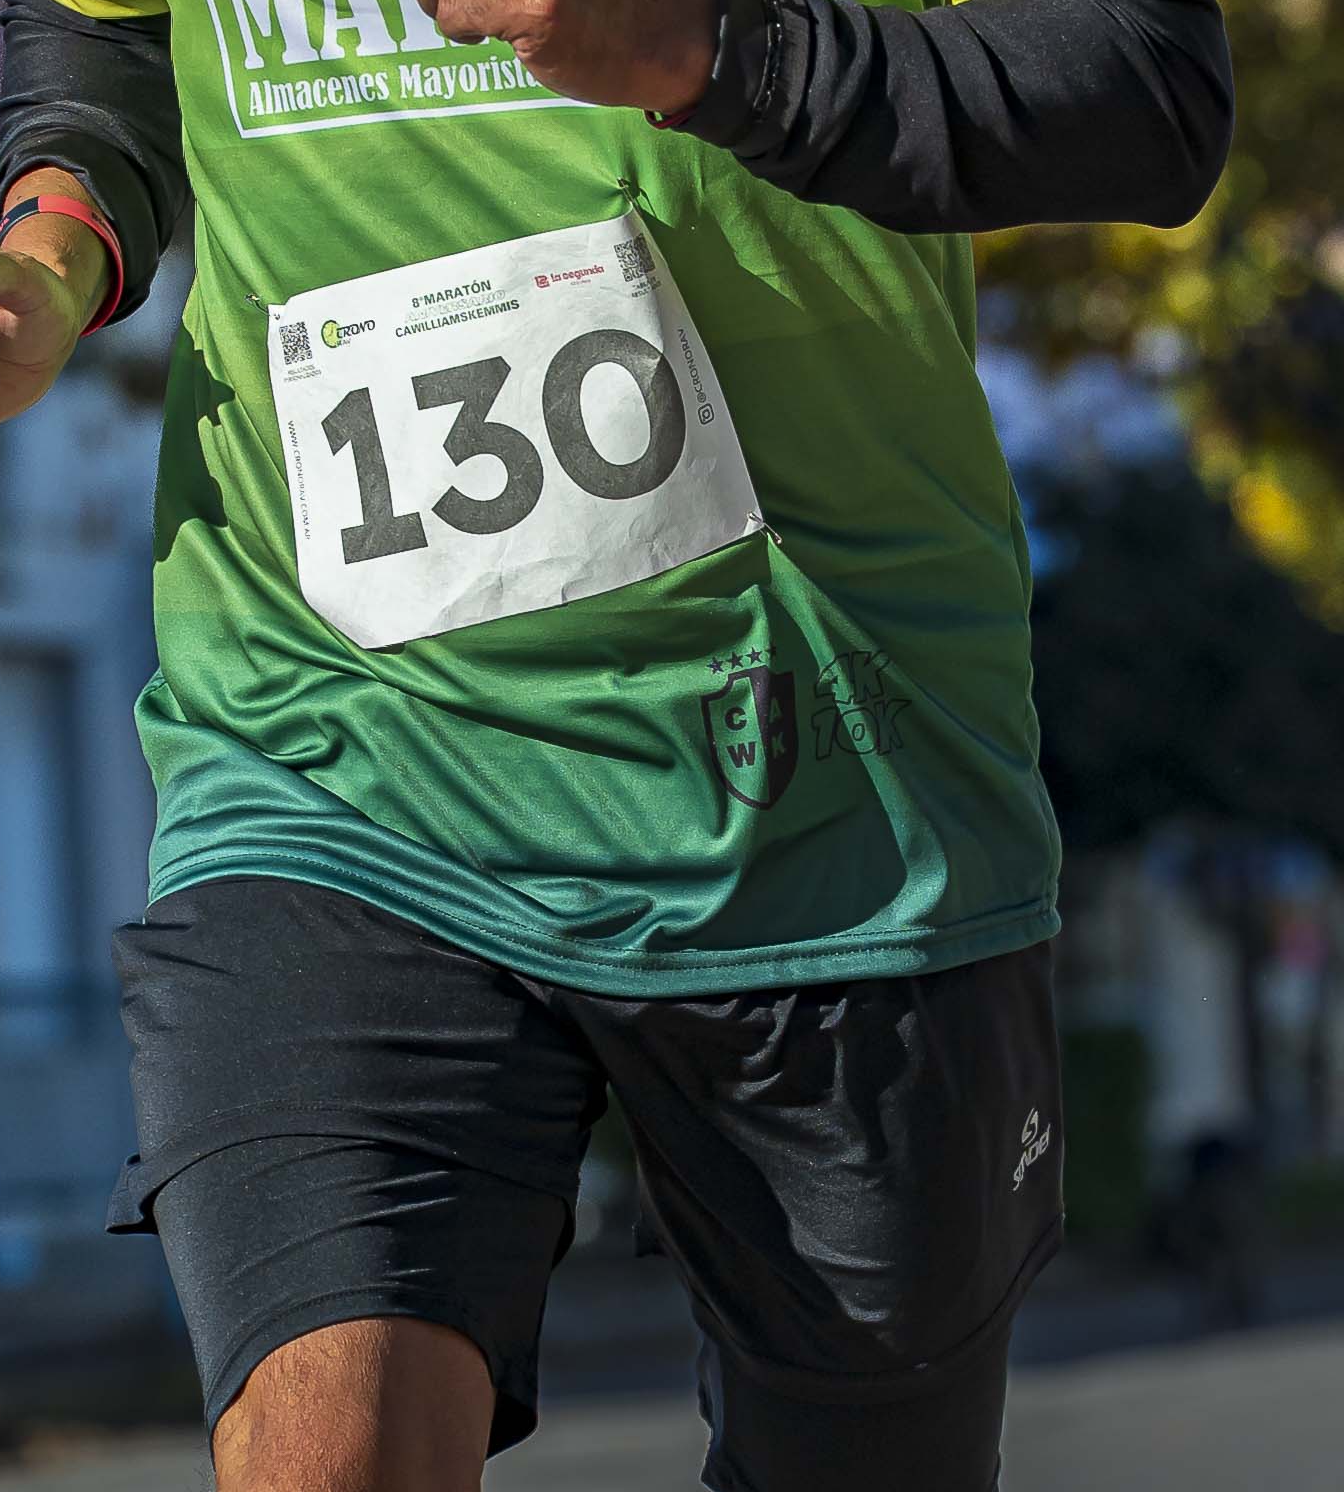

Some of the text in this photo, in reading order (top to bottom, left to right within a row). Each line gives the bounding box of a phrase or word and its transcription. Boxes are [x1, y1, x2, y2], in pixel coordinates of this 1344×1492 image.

[249, 71, 389, 117] Almacenes
[395, 299, 520, 338] CAWILLIAMSKEMMIS
[321, 329, 686, 564] 130
[811, 699, 912, 761] 10K
